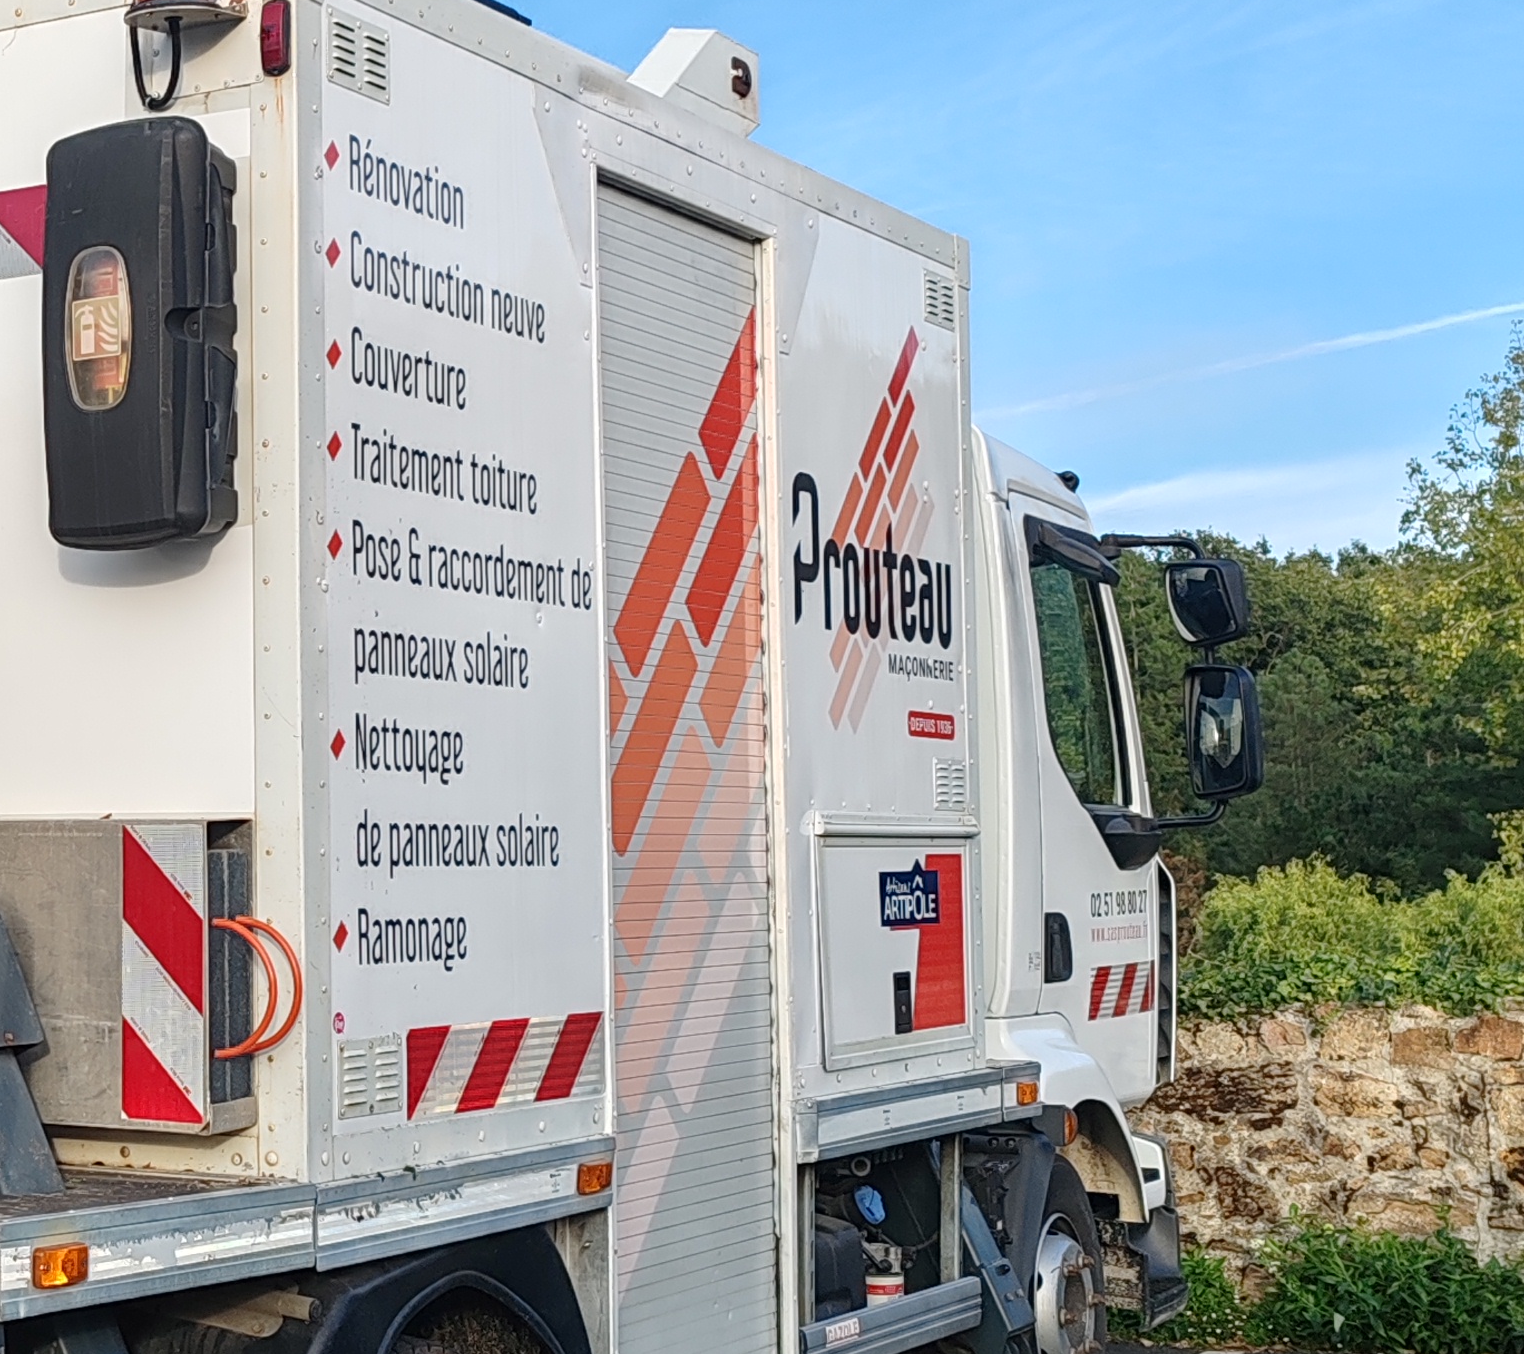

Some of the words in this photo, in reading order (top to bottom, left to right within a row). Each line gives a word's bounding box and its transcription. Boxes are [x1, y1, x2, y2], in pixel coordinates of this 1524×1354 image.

[349, 134, 464, 230] Rénovation
[350, 230, 484, 325] Construction
[490, 288, 545, 343] neuve
[351, 326, 466, 410] Couverture
[351, 422, 465, 502] Traitement
[470, 453, 537, 515] toiture
[352, 519, 402, 582] Pose
[408, 528, 423, 586] &
[428, 542, 566, 607] raccordement
[571, 558, 592, 611] de
[792, 472, 951, 650] Prouteau
[354, 625, 458, 685] panneaux
[463, 631, 529, 689] solaire
[888, 653, 954, 682] MAÇONNERIE
[355, 712, 464, 786] Nettoyage
[356, 808, 382, 868] de
[388, 819, 491, 879] panneaux
[496, 813, 560, 867] solaire
[357, 907, 467, 972] Ramonage
[1090, 892, 1102, 918] 02
[1104, 892, 1114, 917] 51
[1116, 891, 1126, 915] 98
[1127, 890, 1137, 915] 80
[1138, 889, 1147, 914] 27
